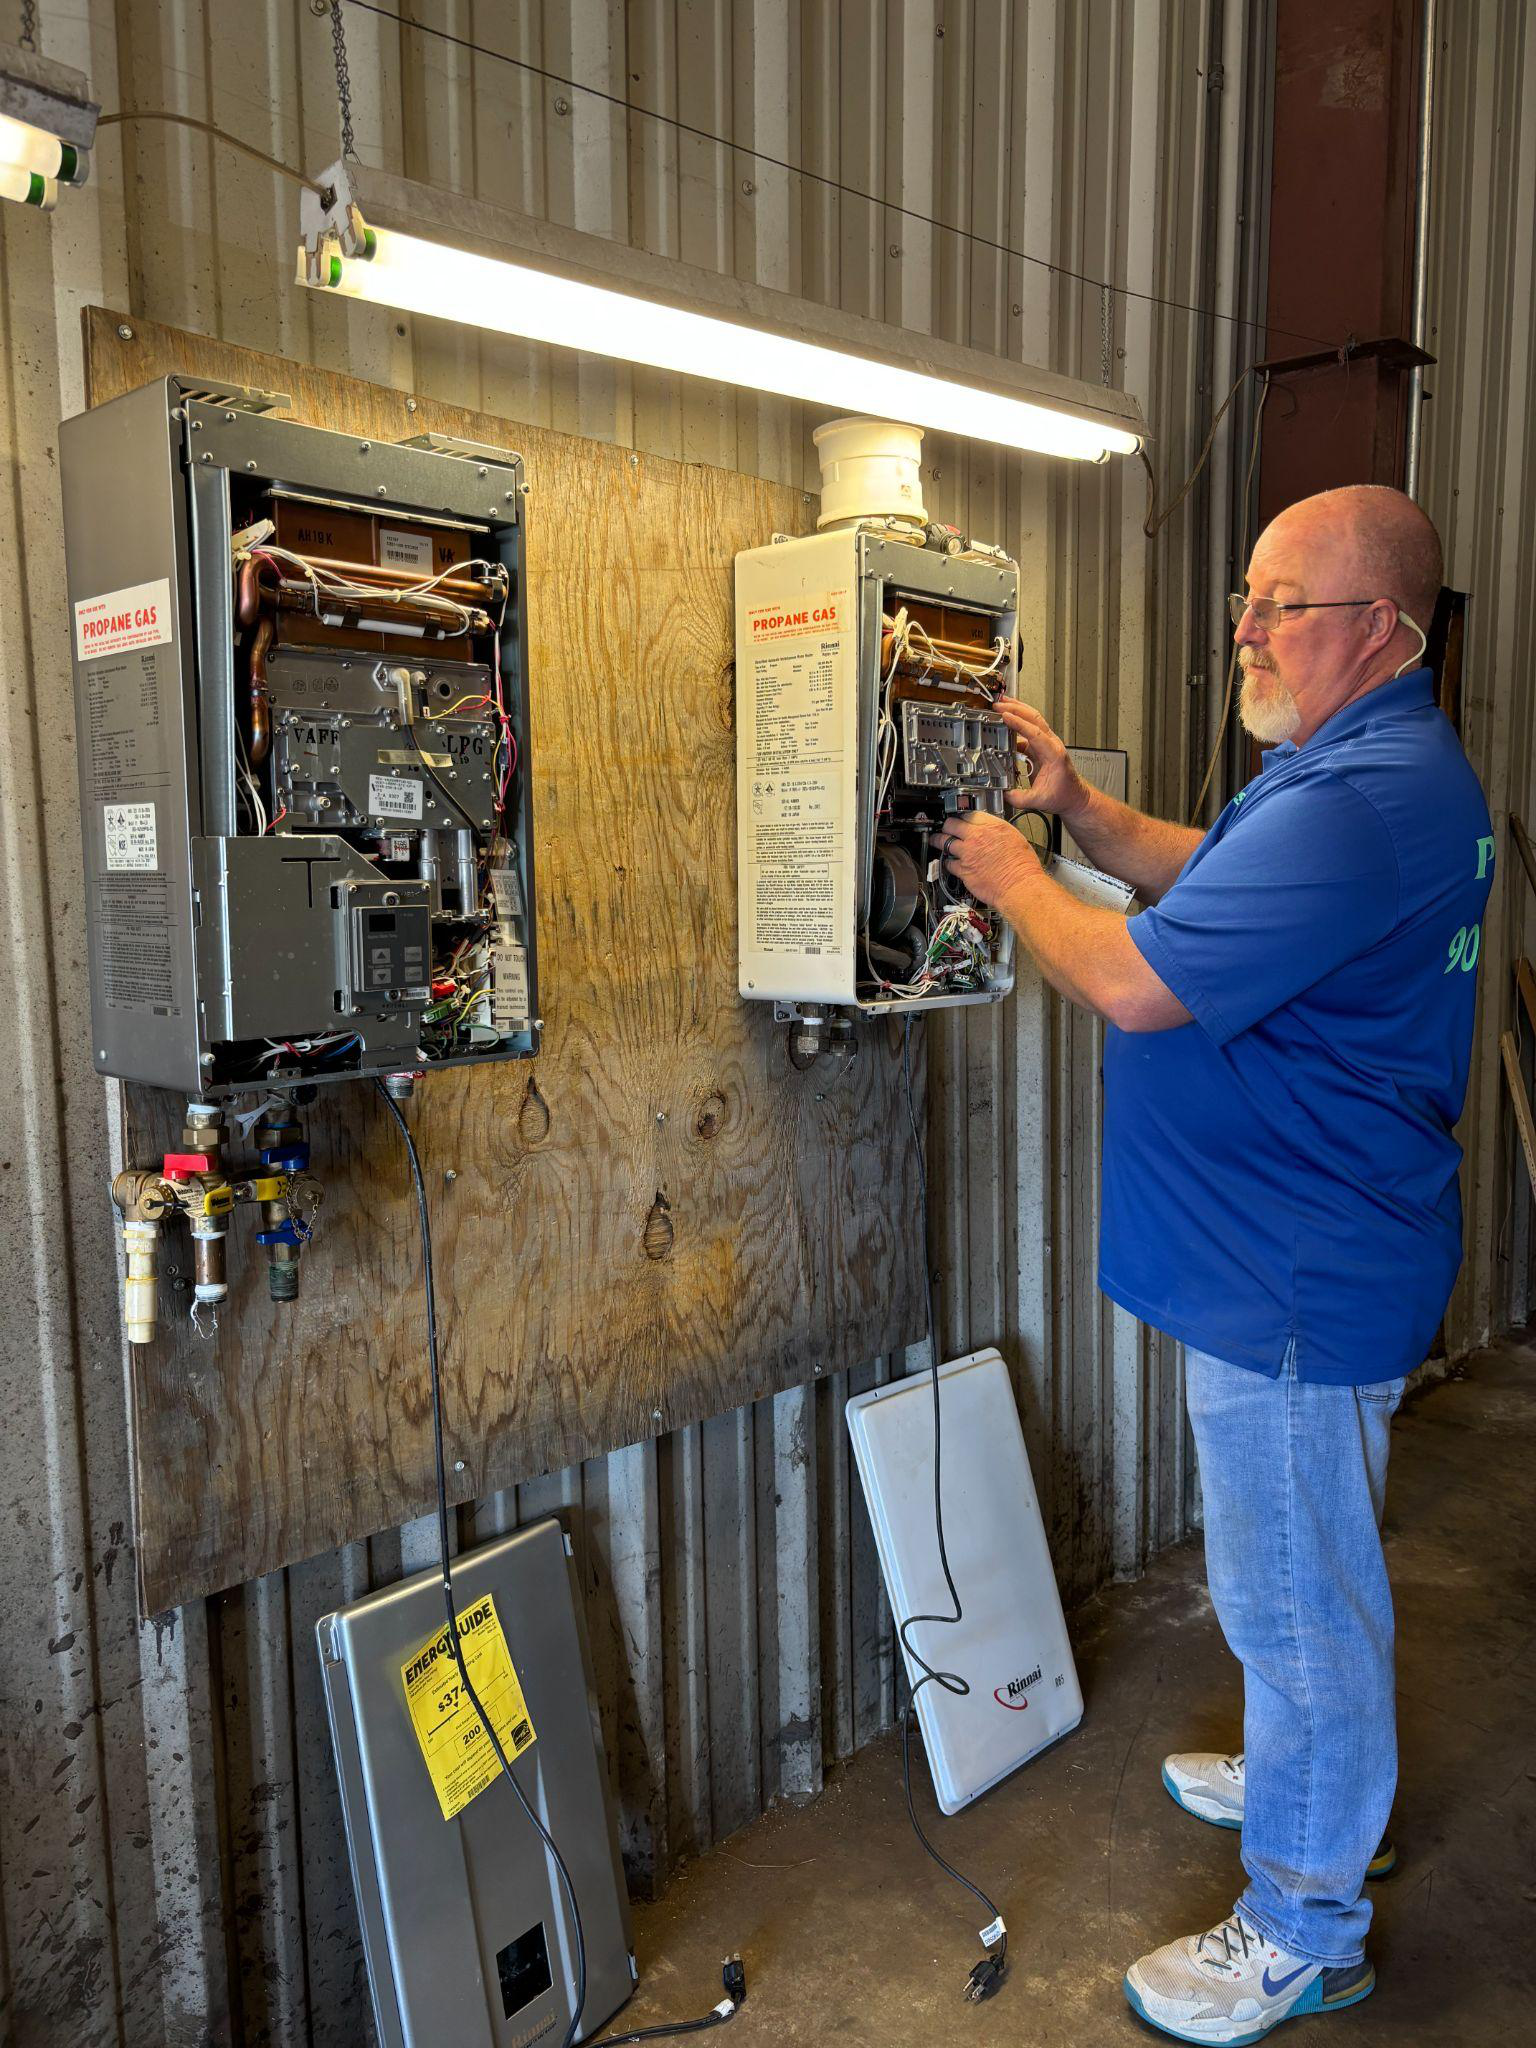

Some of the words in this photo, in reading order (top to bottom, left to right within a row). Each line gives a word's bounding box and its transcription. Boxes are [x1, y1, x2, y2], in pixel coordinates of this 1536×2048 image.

[83, 612, 132, 640] PROPANE
[135, 606, 157, 628] GAS
[753, 612, 809, 632] PROPANE
[812, 606, 836, 622] GAS
[294, 728, 340, 744] VAFF
[446, 734, 483, 756] LPG
[1444, 924, 1480, 974] 90
[502, 972, 520, 980] WARNING
[1007, 1664, 1042, 1698] Rinnai
[463, 1725, 480, 1746] 200
